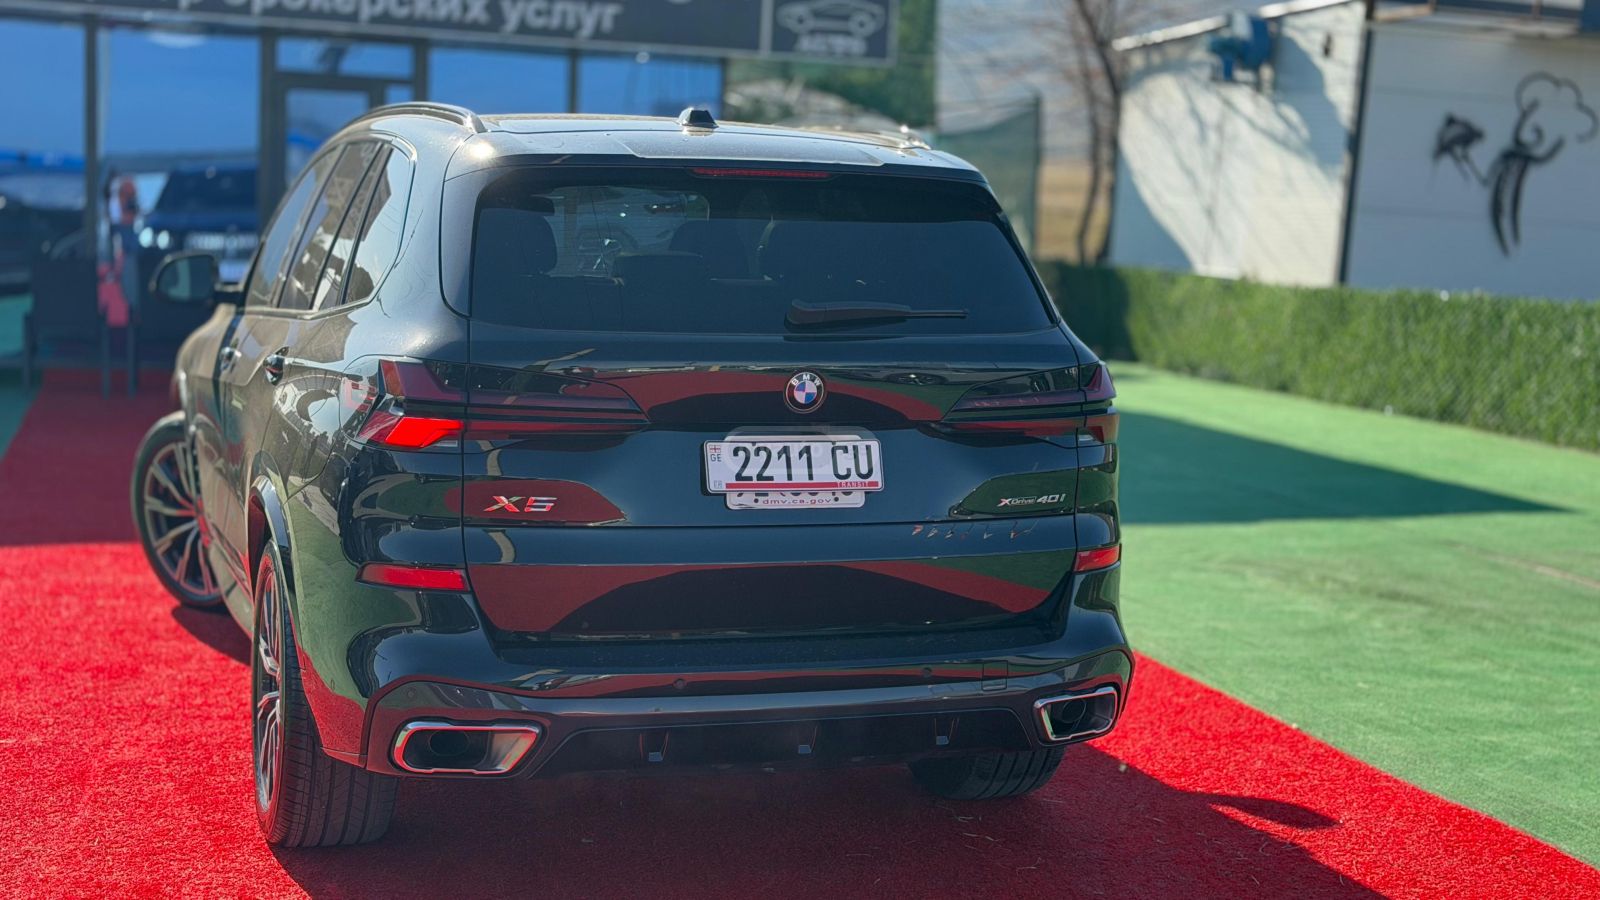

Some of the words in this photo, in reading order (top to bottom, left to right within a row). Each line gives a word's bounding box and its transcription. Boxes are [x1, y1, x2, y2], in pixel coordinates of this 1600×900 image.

[223, 0, 492, 24] ерских
[502, 0, 624, 38] услуг
[791, 374, 821, 386] BMW
[710, 453, 722, 462] GE
[733, 445, 814, 482] 2211
[831, 444, 874, 481] CU
[483, 495, 558, 513] X5
